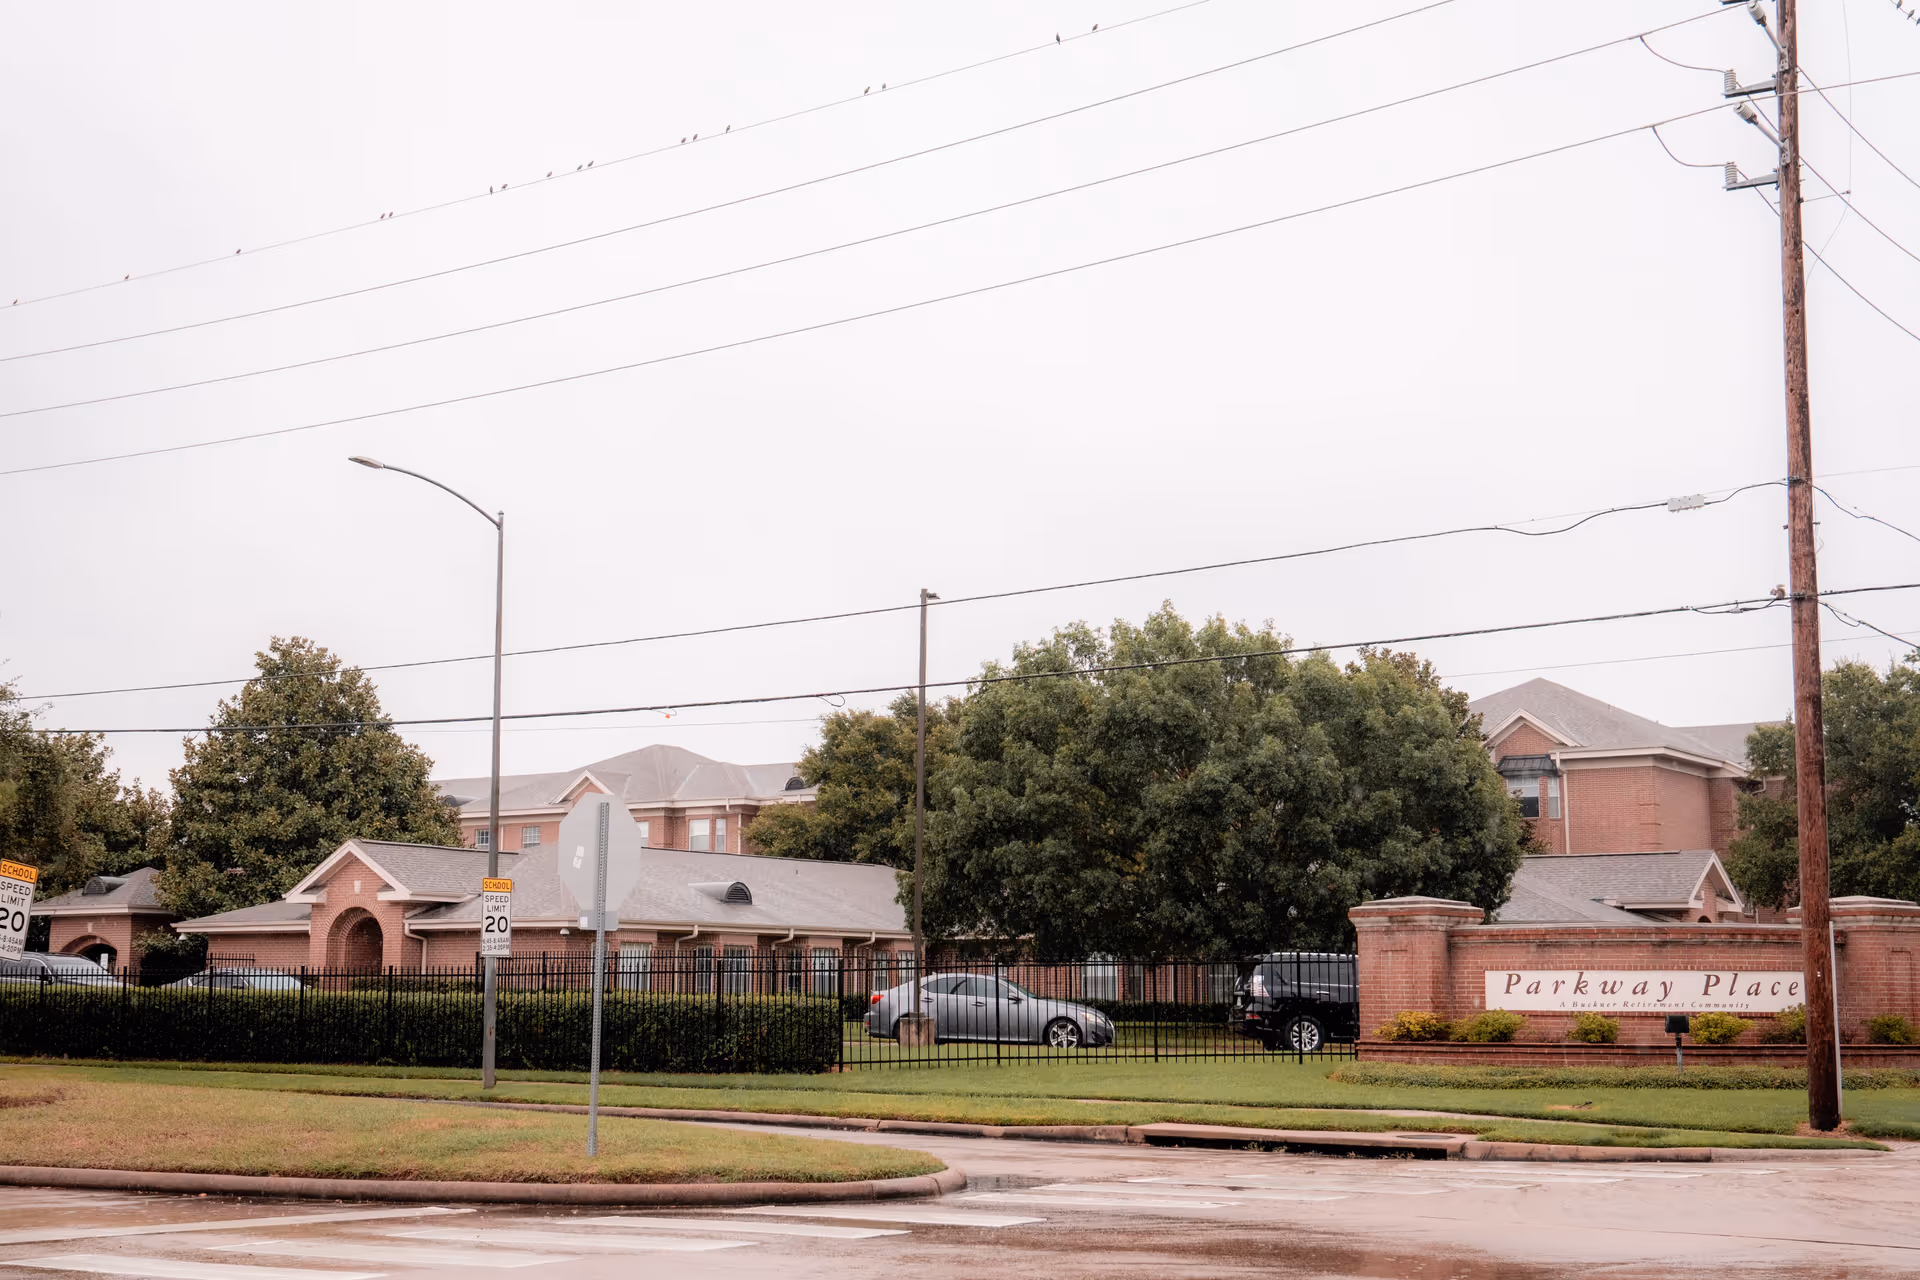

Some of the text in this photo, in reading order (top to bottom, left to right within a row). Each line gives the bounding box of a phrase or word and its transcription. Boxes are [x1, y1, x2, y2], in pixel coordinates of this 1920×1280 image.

[2, 864, 34, 880] SCHOOL
[0, 881, 31, 896] SPEED
[484, 881, 510, 890] SCHOOL
[1, 893, 26, 908] LIMIT
[485, 895, 509, 903] SPEED
[0, 907, 25, 932] 20
[485, 916, 508, 933] 20
[1504, 971, 1799, 1002] Parkway Place
[1691, 1001, 1750, 1009] Community
